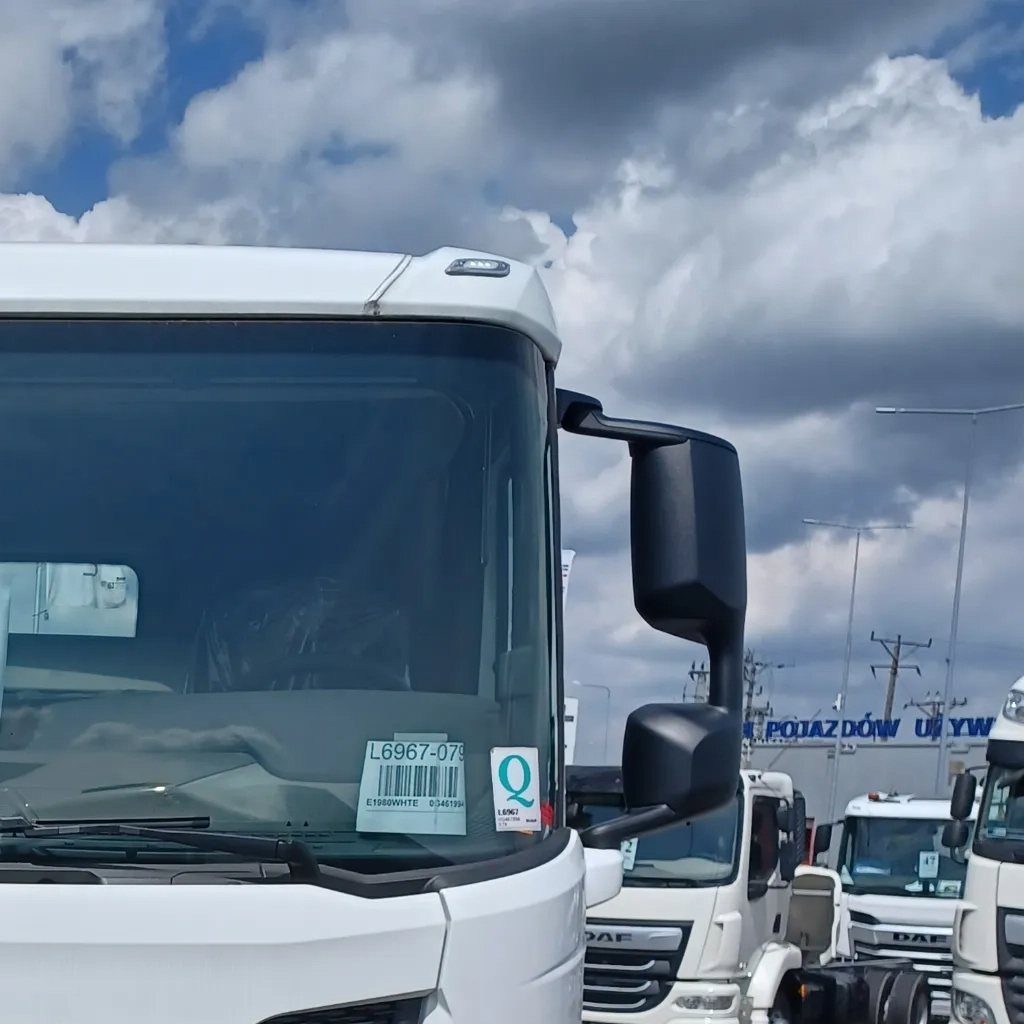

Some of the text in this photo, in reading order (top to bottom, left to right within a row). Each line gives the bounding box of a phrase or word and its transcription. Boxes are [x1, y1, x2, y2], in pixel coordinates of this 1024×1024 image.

[766, 712, 901, 738] POJAZDÓW
[370, 743, 464, 761] L6967-079
[498, 754, 535, 808] Q
[892, 932, 948, 943] DAF
